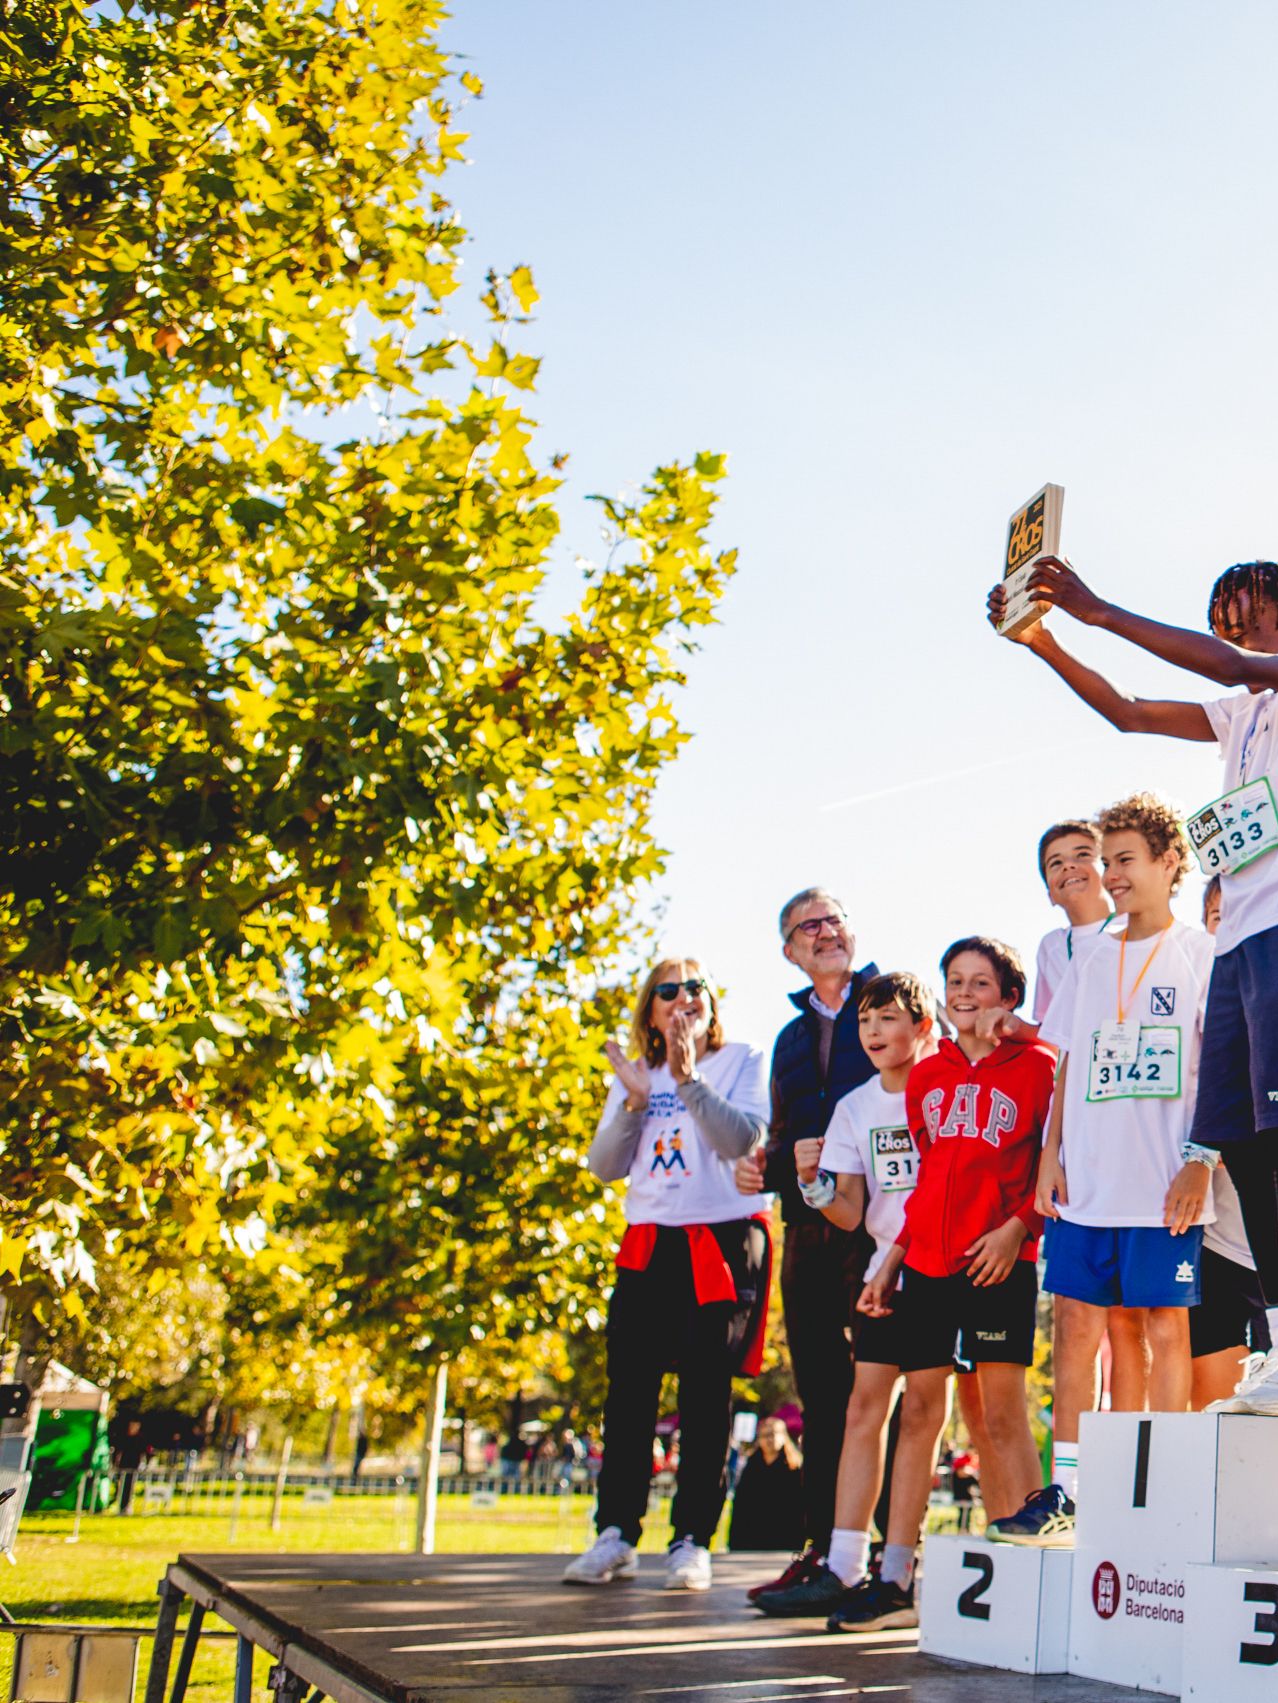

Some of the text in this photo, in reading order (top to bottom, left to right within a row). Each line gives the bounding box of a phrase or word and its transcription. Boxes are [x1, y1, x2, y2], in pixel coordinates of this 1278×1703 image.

[1207, 822, 1263, 867] 3133
[1099, 1063, 1161, 1084] 3142
[921, 1083, 1018, 1148] GAP
[878, 1137, 910, 1151] CROS
[1132, 1420, 1151, 1508] 1
[956, 1551, 994, 1621] 2
[1126, 1573, 1185, 1598] Diputació
[1125, 1598, 1184, 1624] Barcelona
